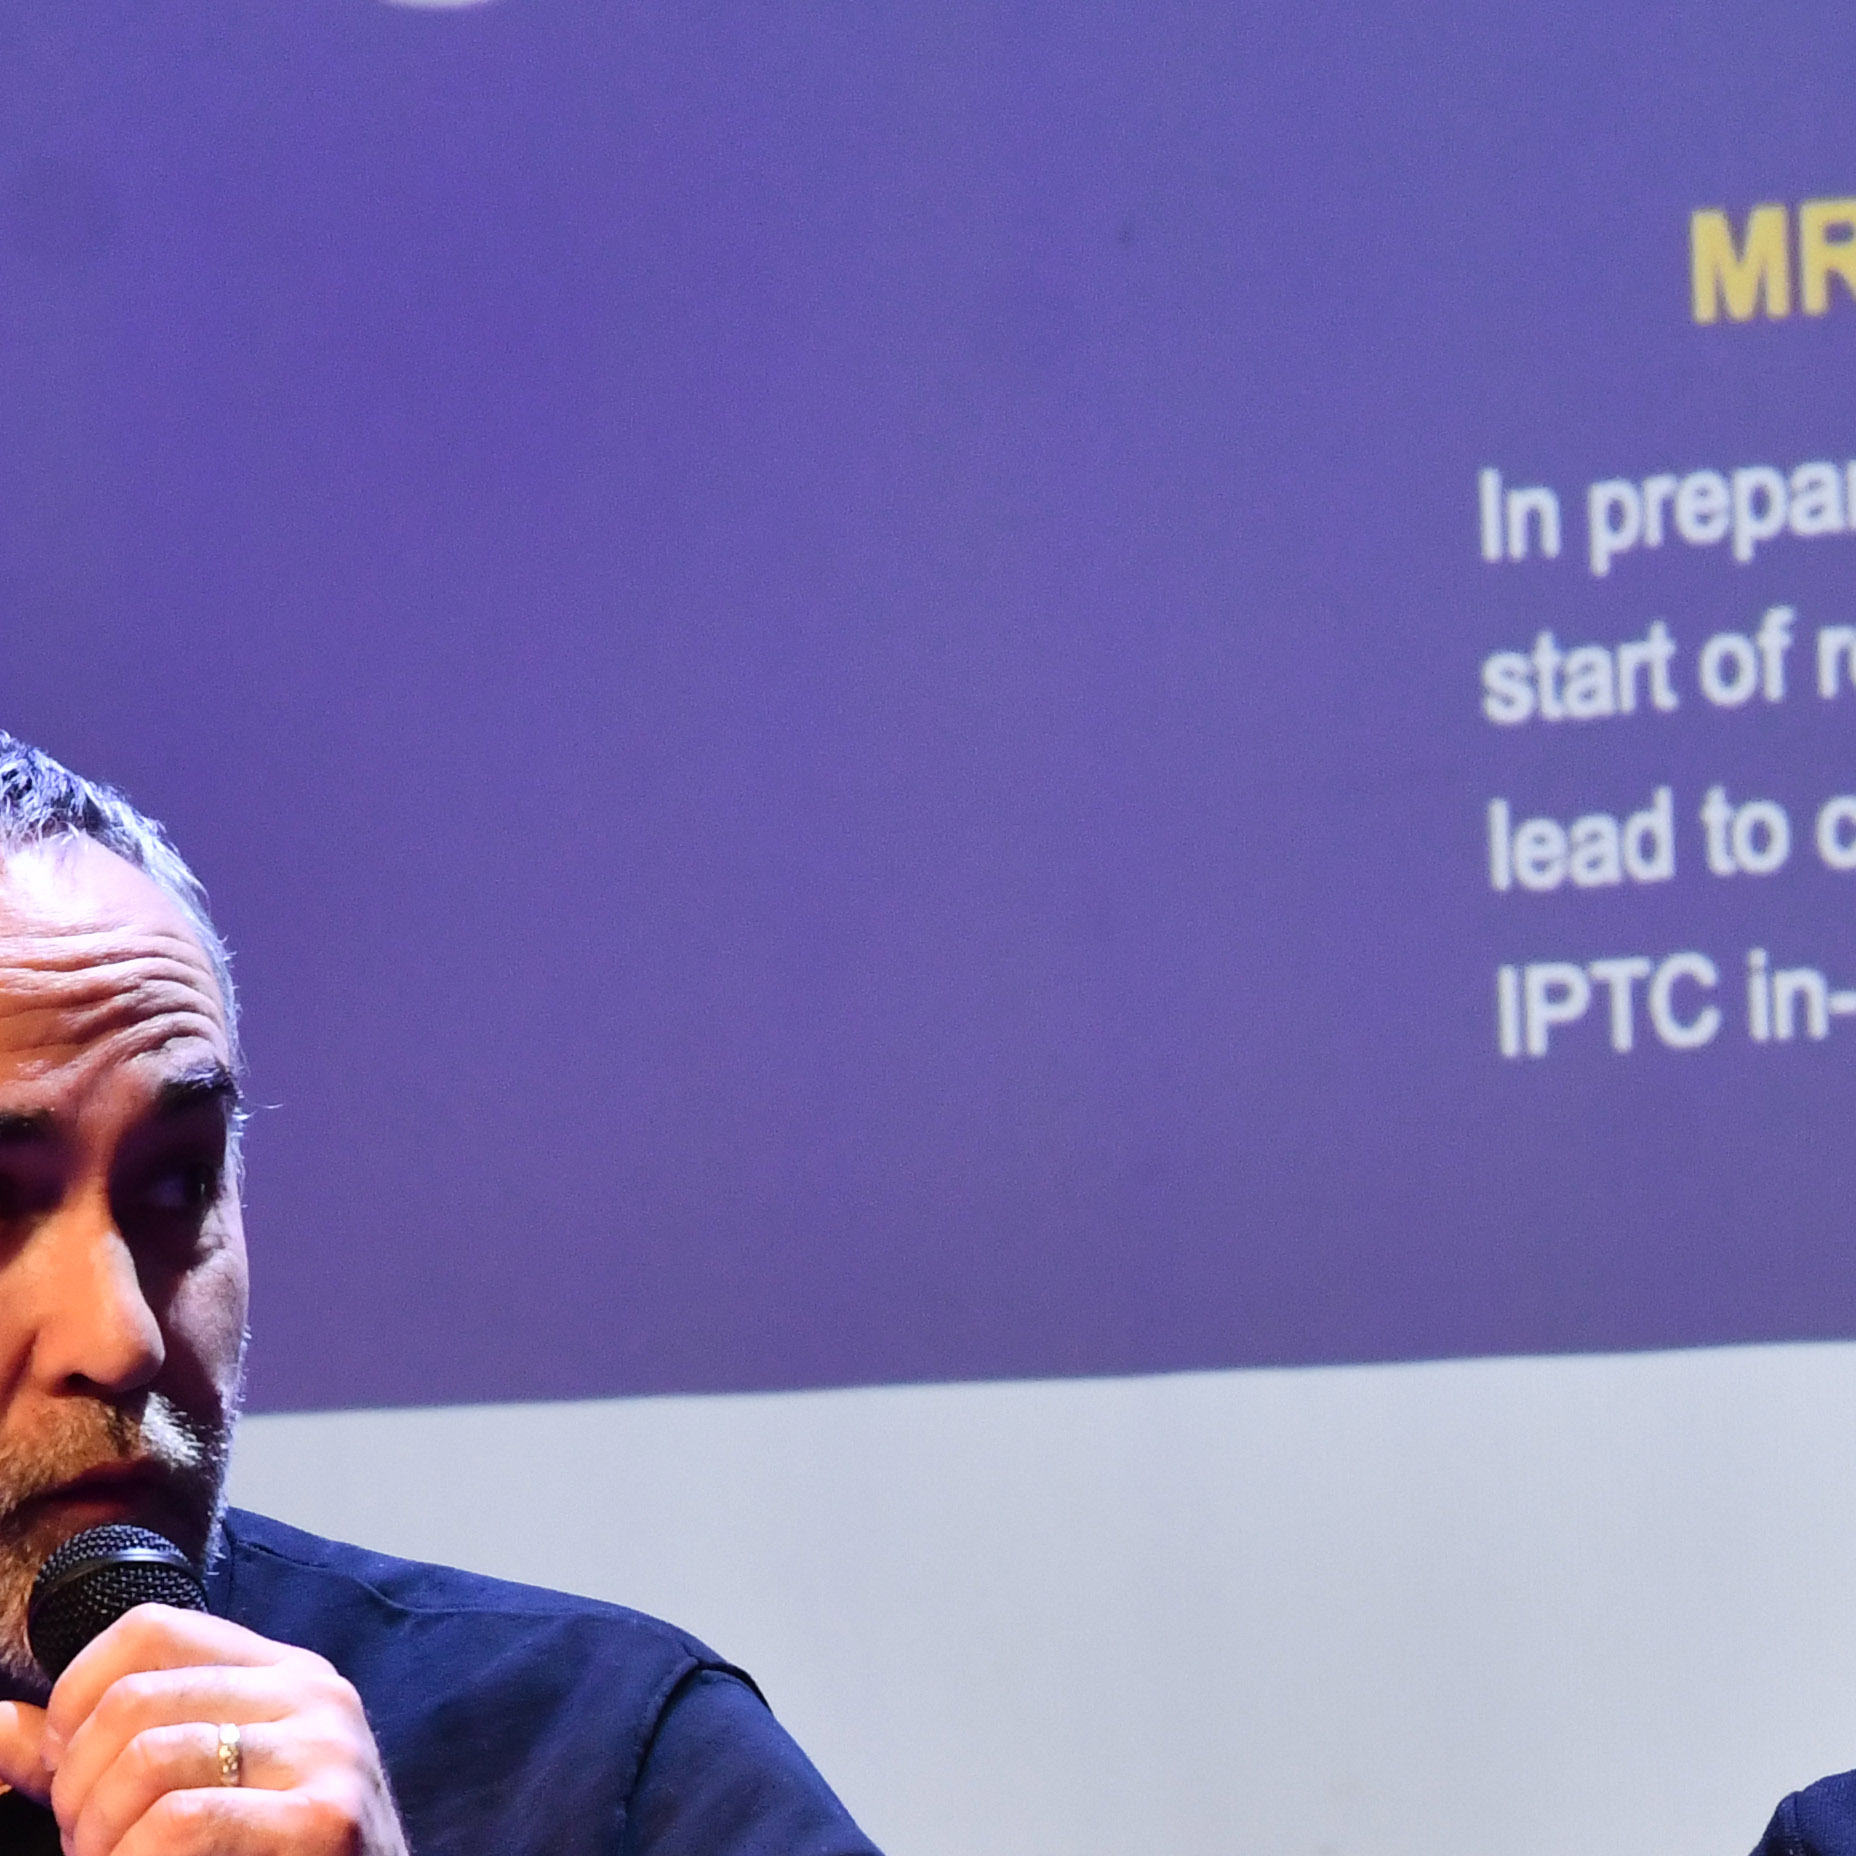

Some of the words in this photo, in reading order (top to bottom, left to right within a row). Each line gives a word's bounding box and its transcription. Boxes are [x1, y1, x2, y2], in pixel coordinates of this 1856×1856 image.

[1479, 468, 1562, 561] In
[1481, 620, 1680, 725] start
[1699, 605, 1796, 707] of
[1488, 786, 1676, 891] lead
[1700, 785, 1792, 876] to
[1497, 951, 1722, 1057] IPTC
